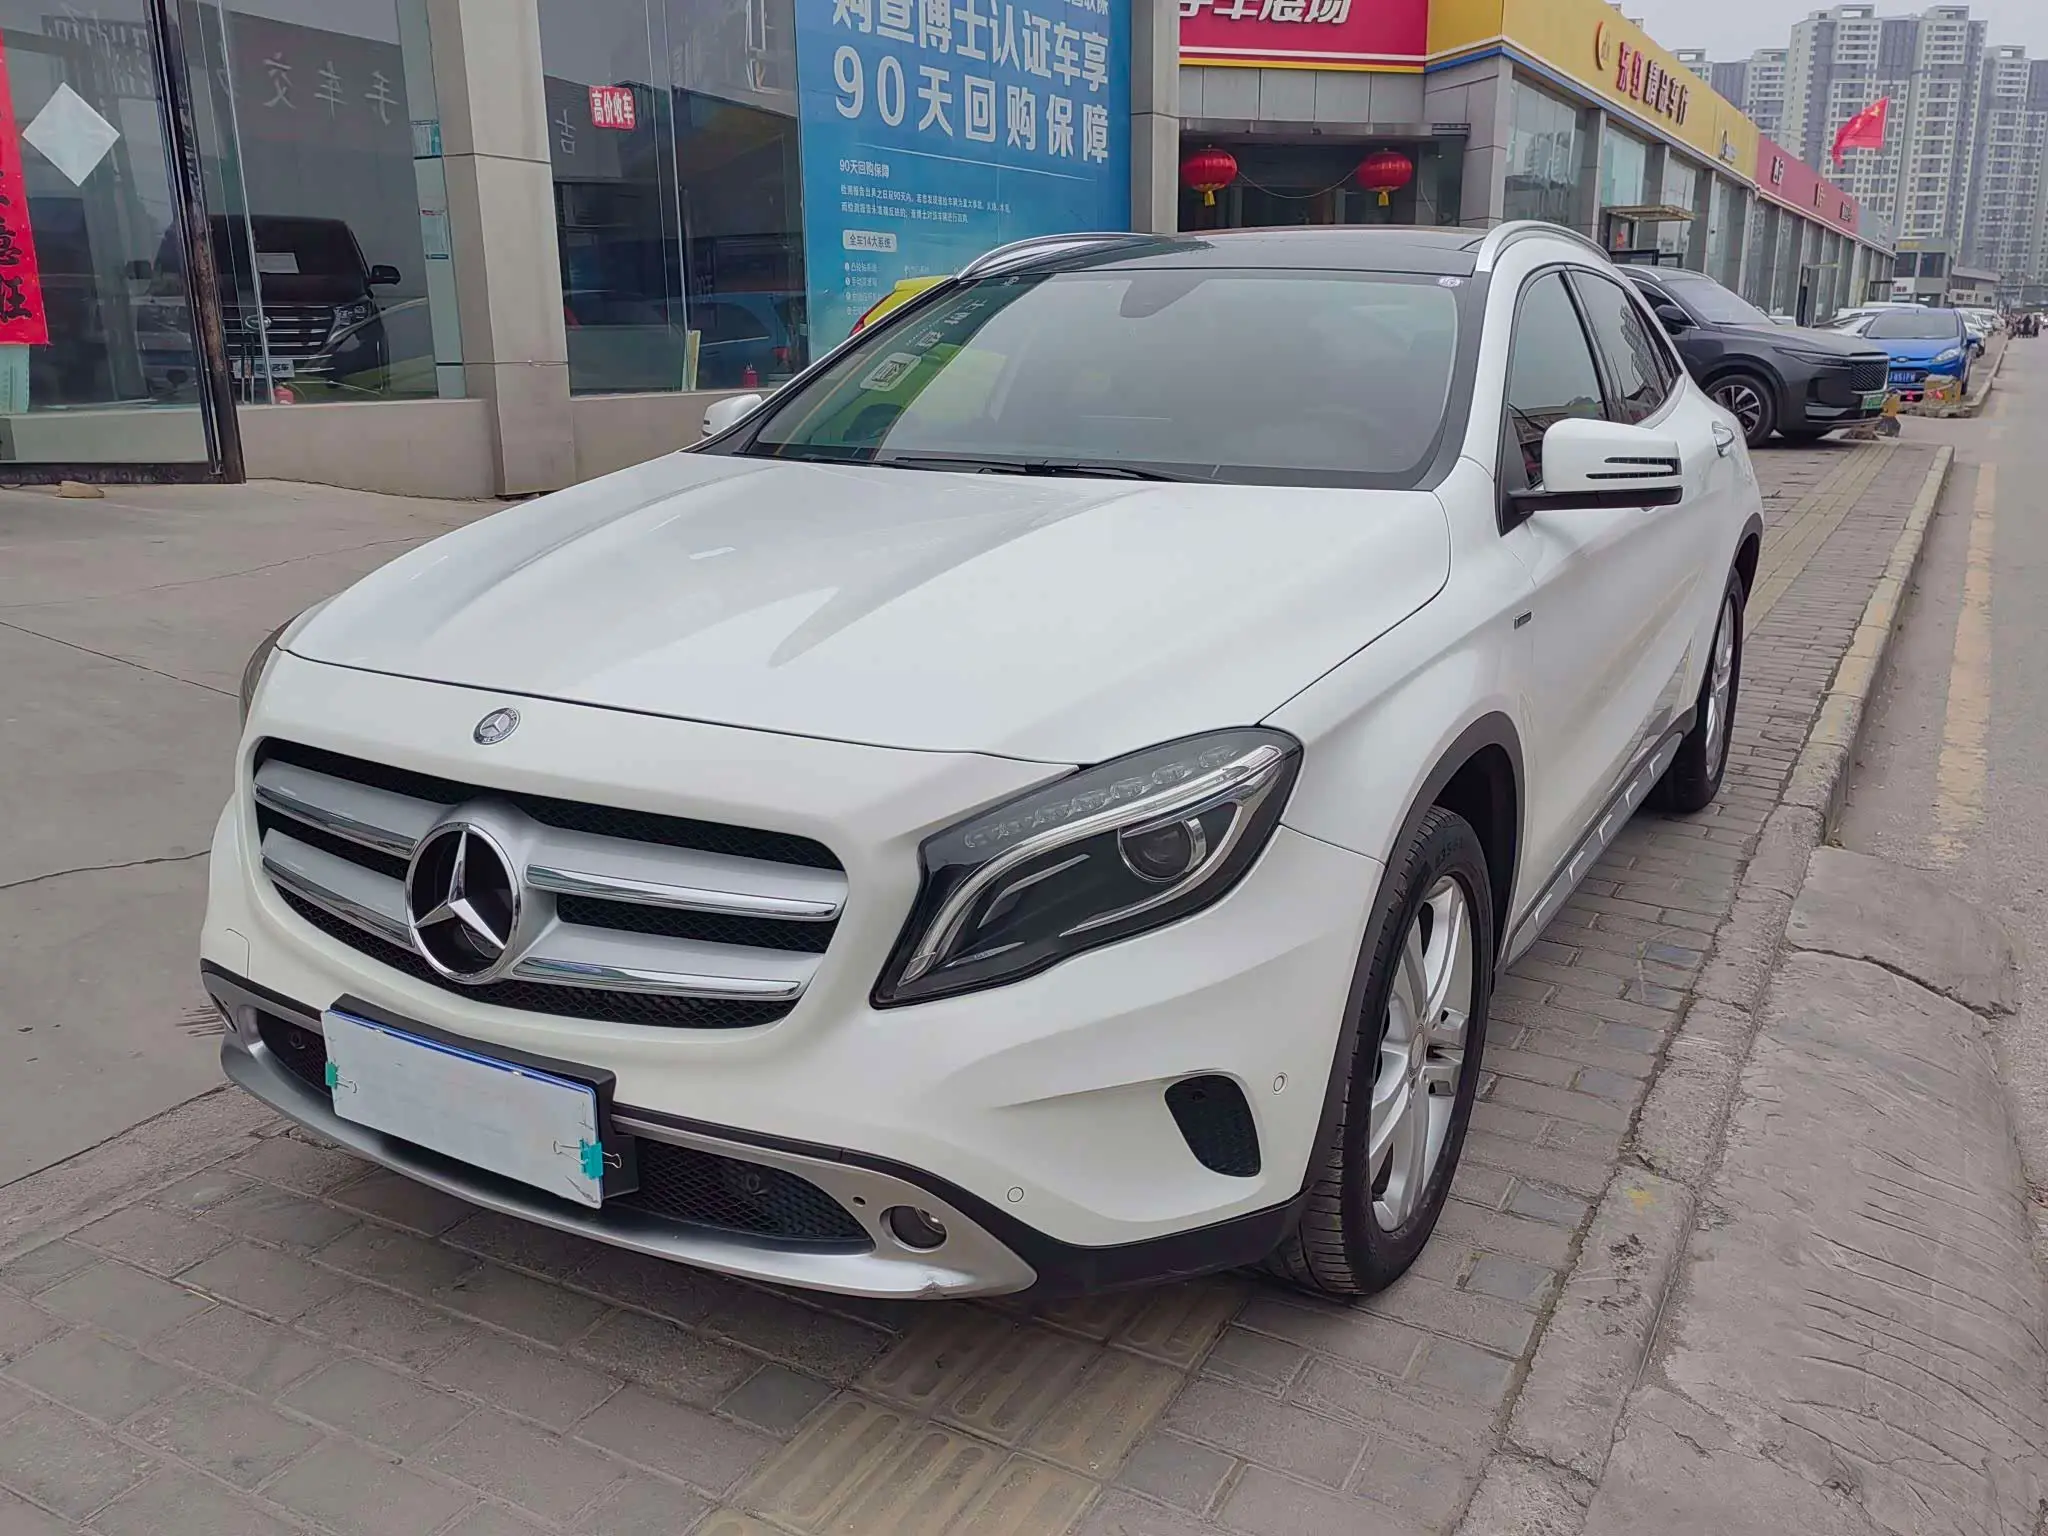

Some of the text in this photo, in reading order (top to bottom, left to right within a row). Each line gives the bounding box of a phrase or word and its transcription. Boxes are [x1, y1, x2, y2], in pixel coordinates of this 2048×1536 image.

[591, 90, 634, 125] 高价收车
[833, 45, 1109, 164] 90天回购保障
